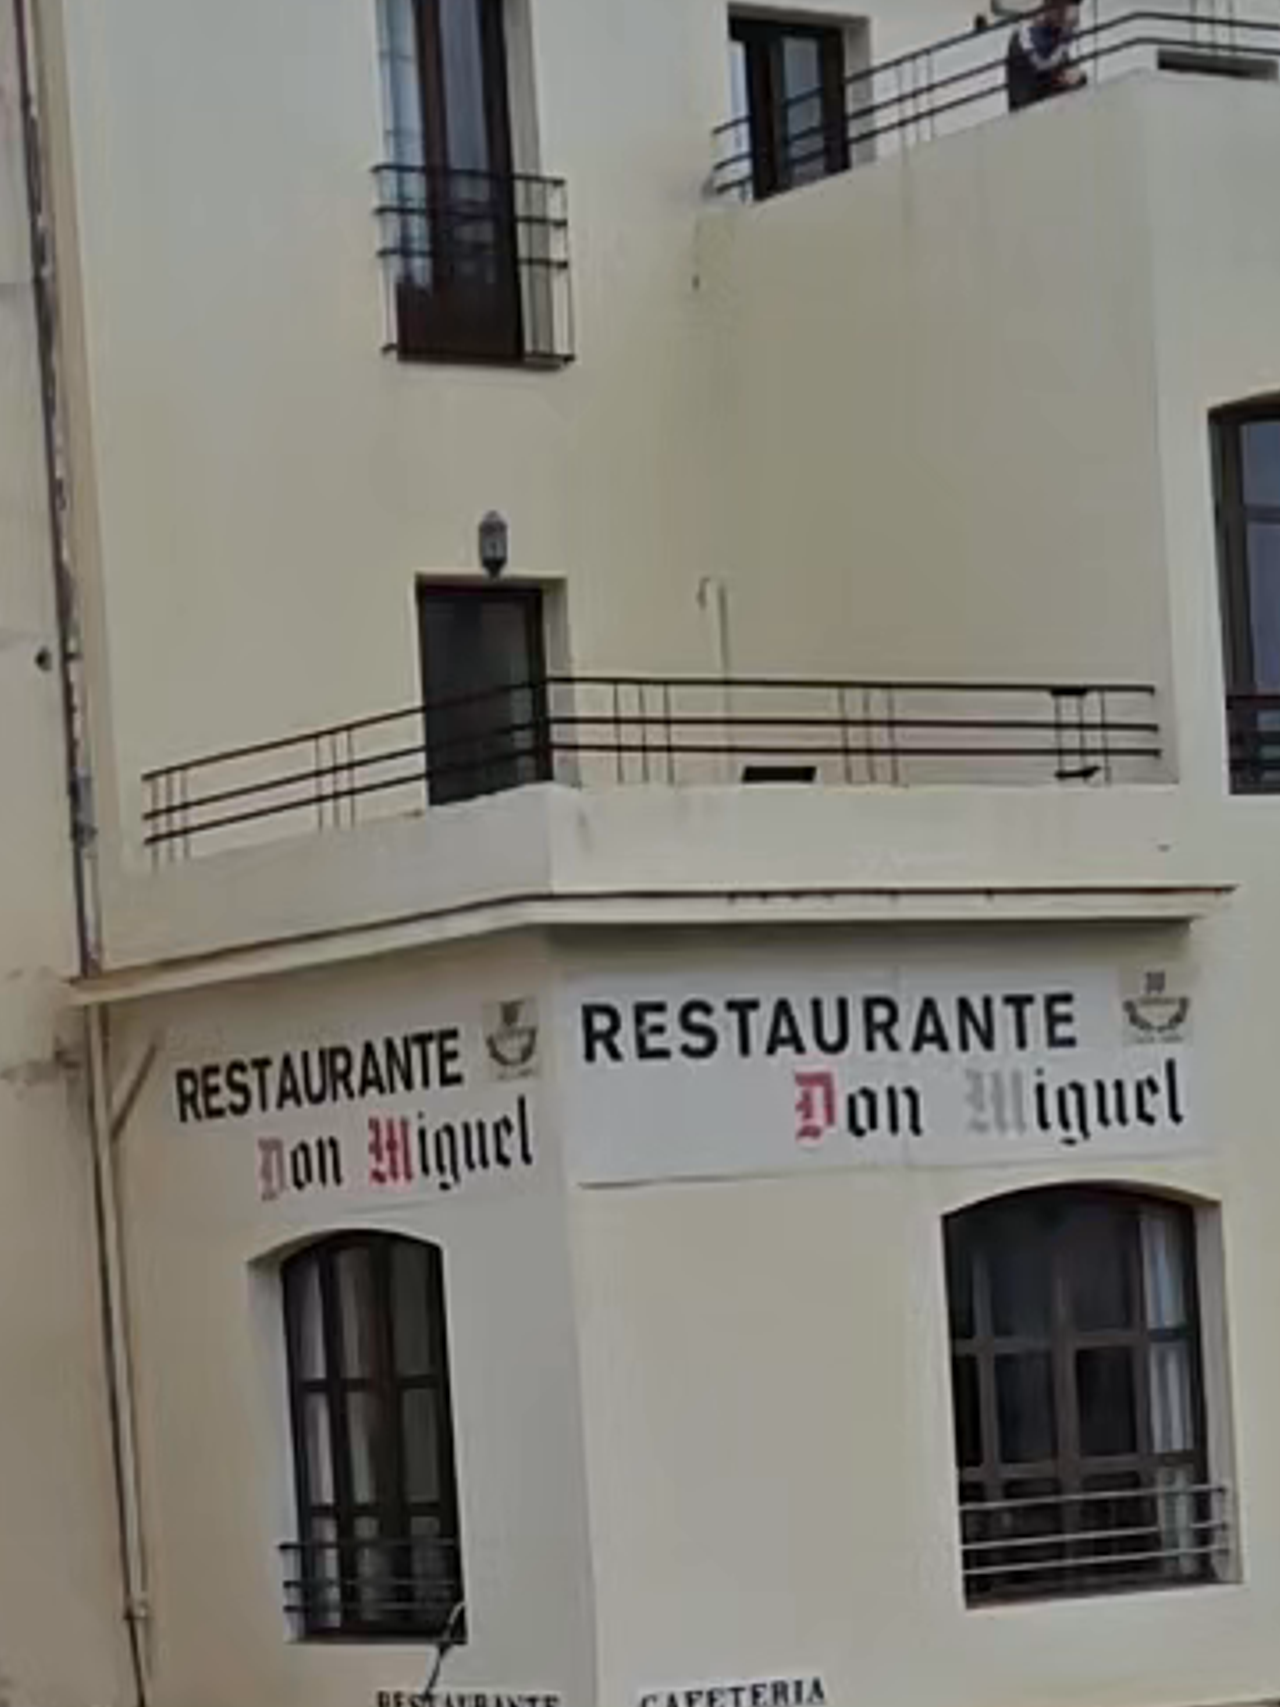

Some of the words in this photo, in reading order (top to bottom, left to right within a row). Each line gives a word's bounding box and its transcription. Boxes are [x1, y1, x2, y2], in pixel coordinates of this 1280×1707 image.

[581, 993, 1078, 1062] RESTAURANTE
[175, 1028, 463, 1122] RESTAURANTE
[794, 1071, 922, 1141] Don
[963, 1058, 1183, 1146] Miguel
[258, 1136, 342, 1200] Don
[368, 1094, 532, 1191] Miguel
